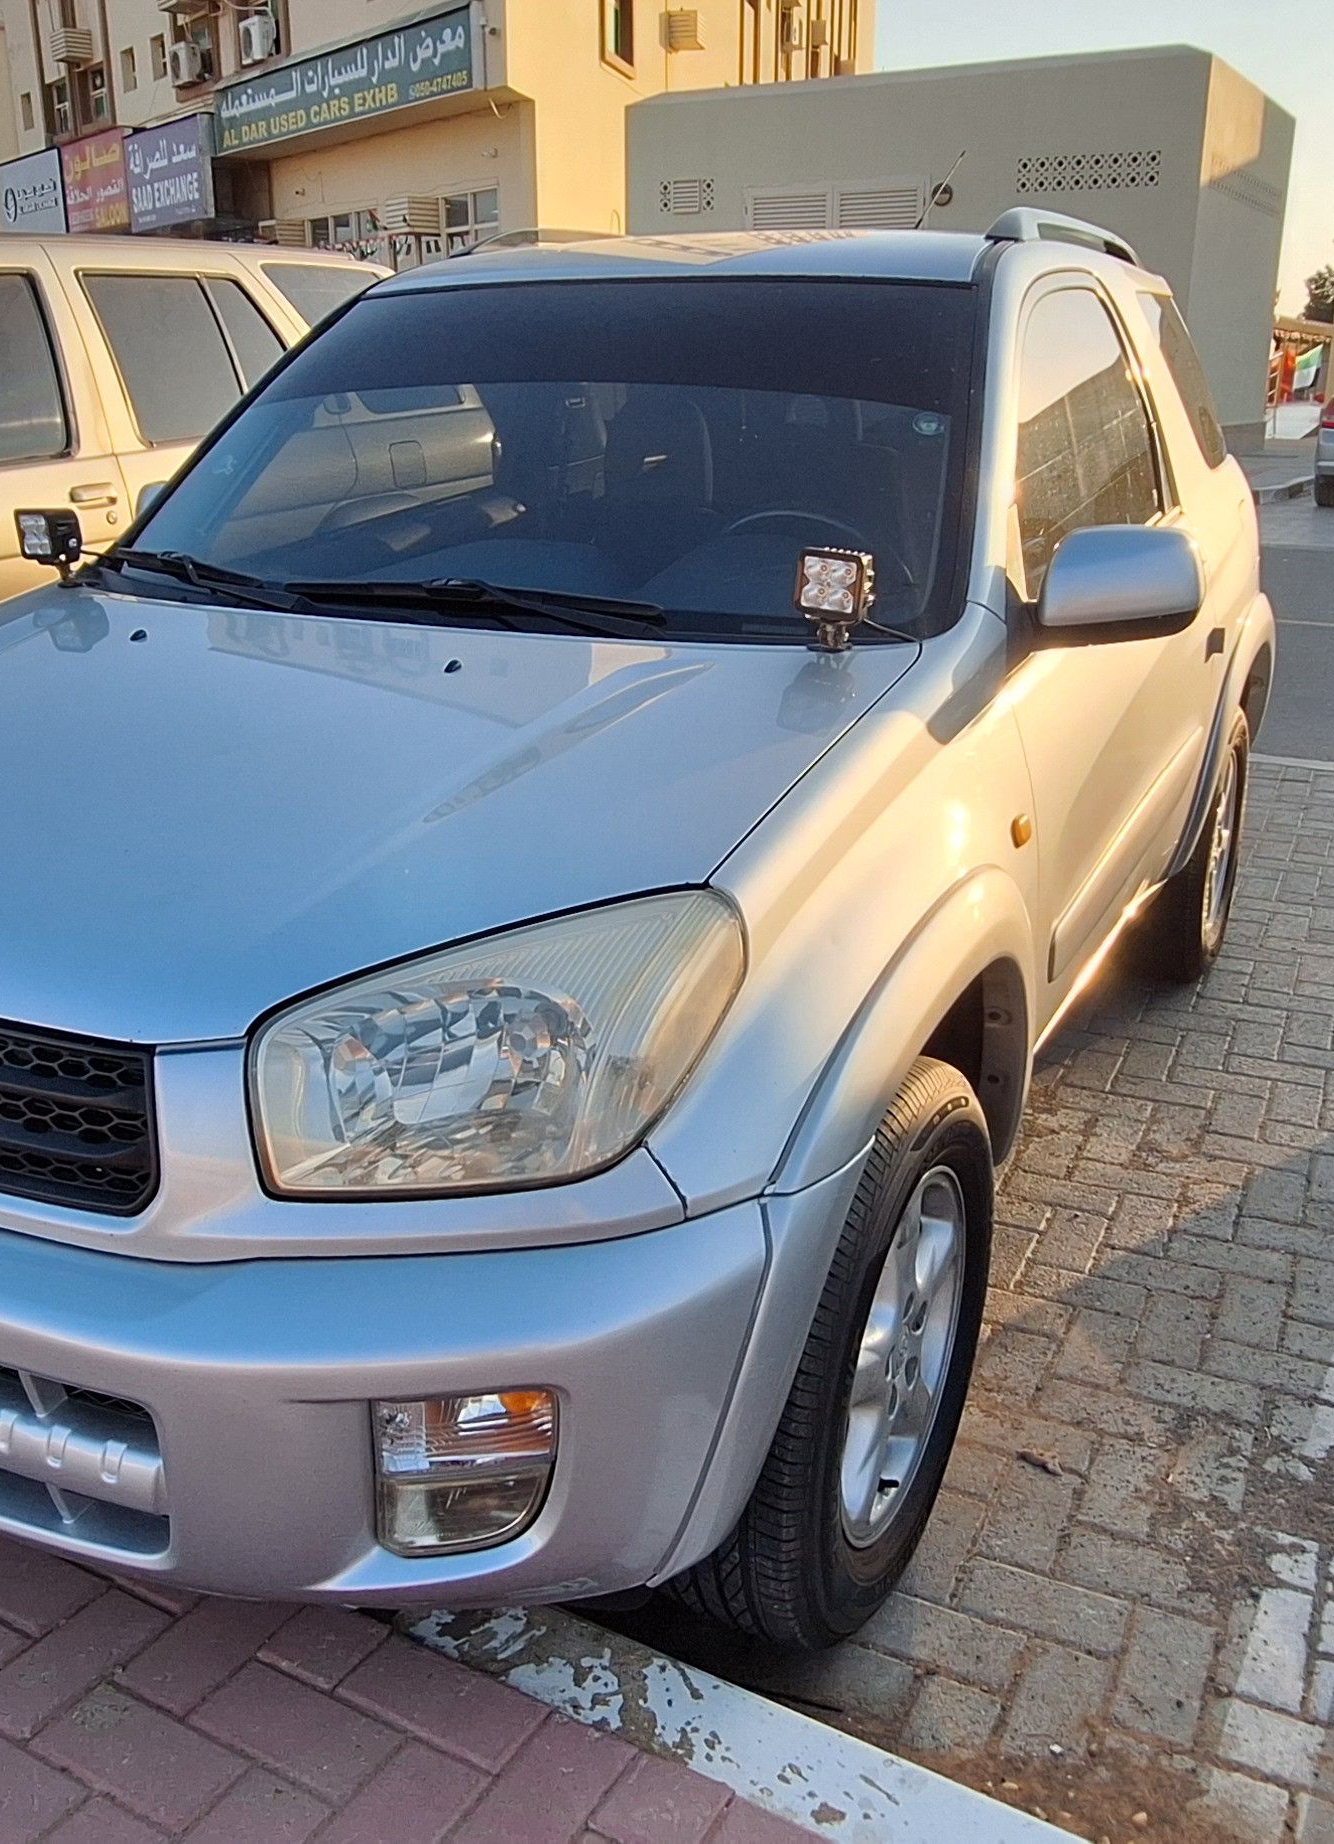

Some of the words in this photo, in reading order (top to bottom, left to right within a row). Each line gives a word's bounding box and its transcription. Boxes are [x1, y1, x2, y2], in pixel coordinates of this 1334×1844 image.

[305, 46, 367, 98] للسيارات
[371, 33, 405, 84] الدار
[409, 25, 465, 72] معرض
[223, 129, 239, 148] AL
[241, 121, 267, 142] DAR
[270, 109, 306, 134] USED
[310, 97, 349, 123] CARS
[354, 83, 398, 113] EXHB
[171, 142, 197, 163] سعد
[132, 184, 153, 213] SAAD
[153, 172, 200, 209] EXCHANGE
